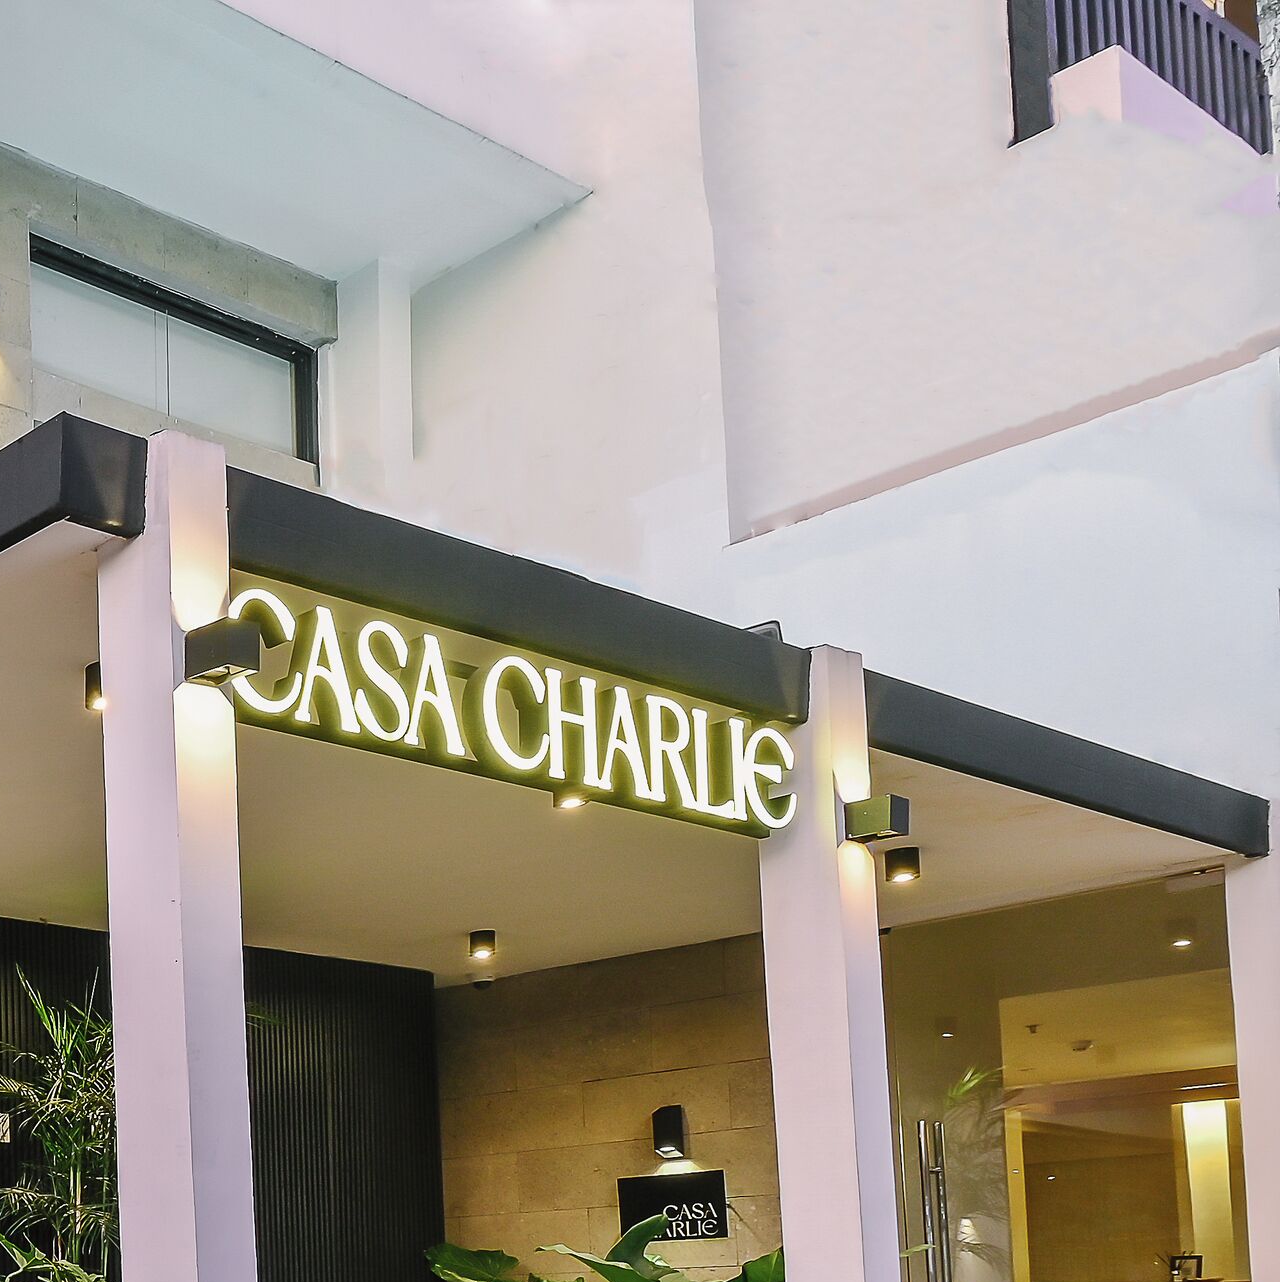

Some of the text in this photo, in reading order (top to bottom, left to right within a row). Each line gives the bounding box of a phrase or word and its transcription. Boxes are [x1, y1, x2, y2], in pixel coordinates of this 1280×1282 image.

[228, 588, 798, 829] CASA CHARLIE
[662, 1202, 718, 1221] CASA
